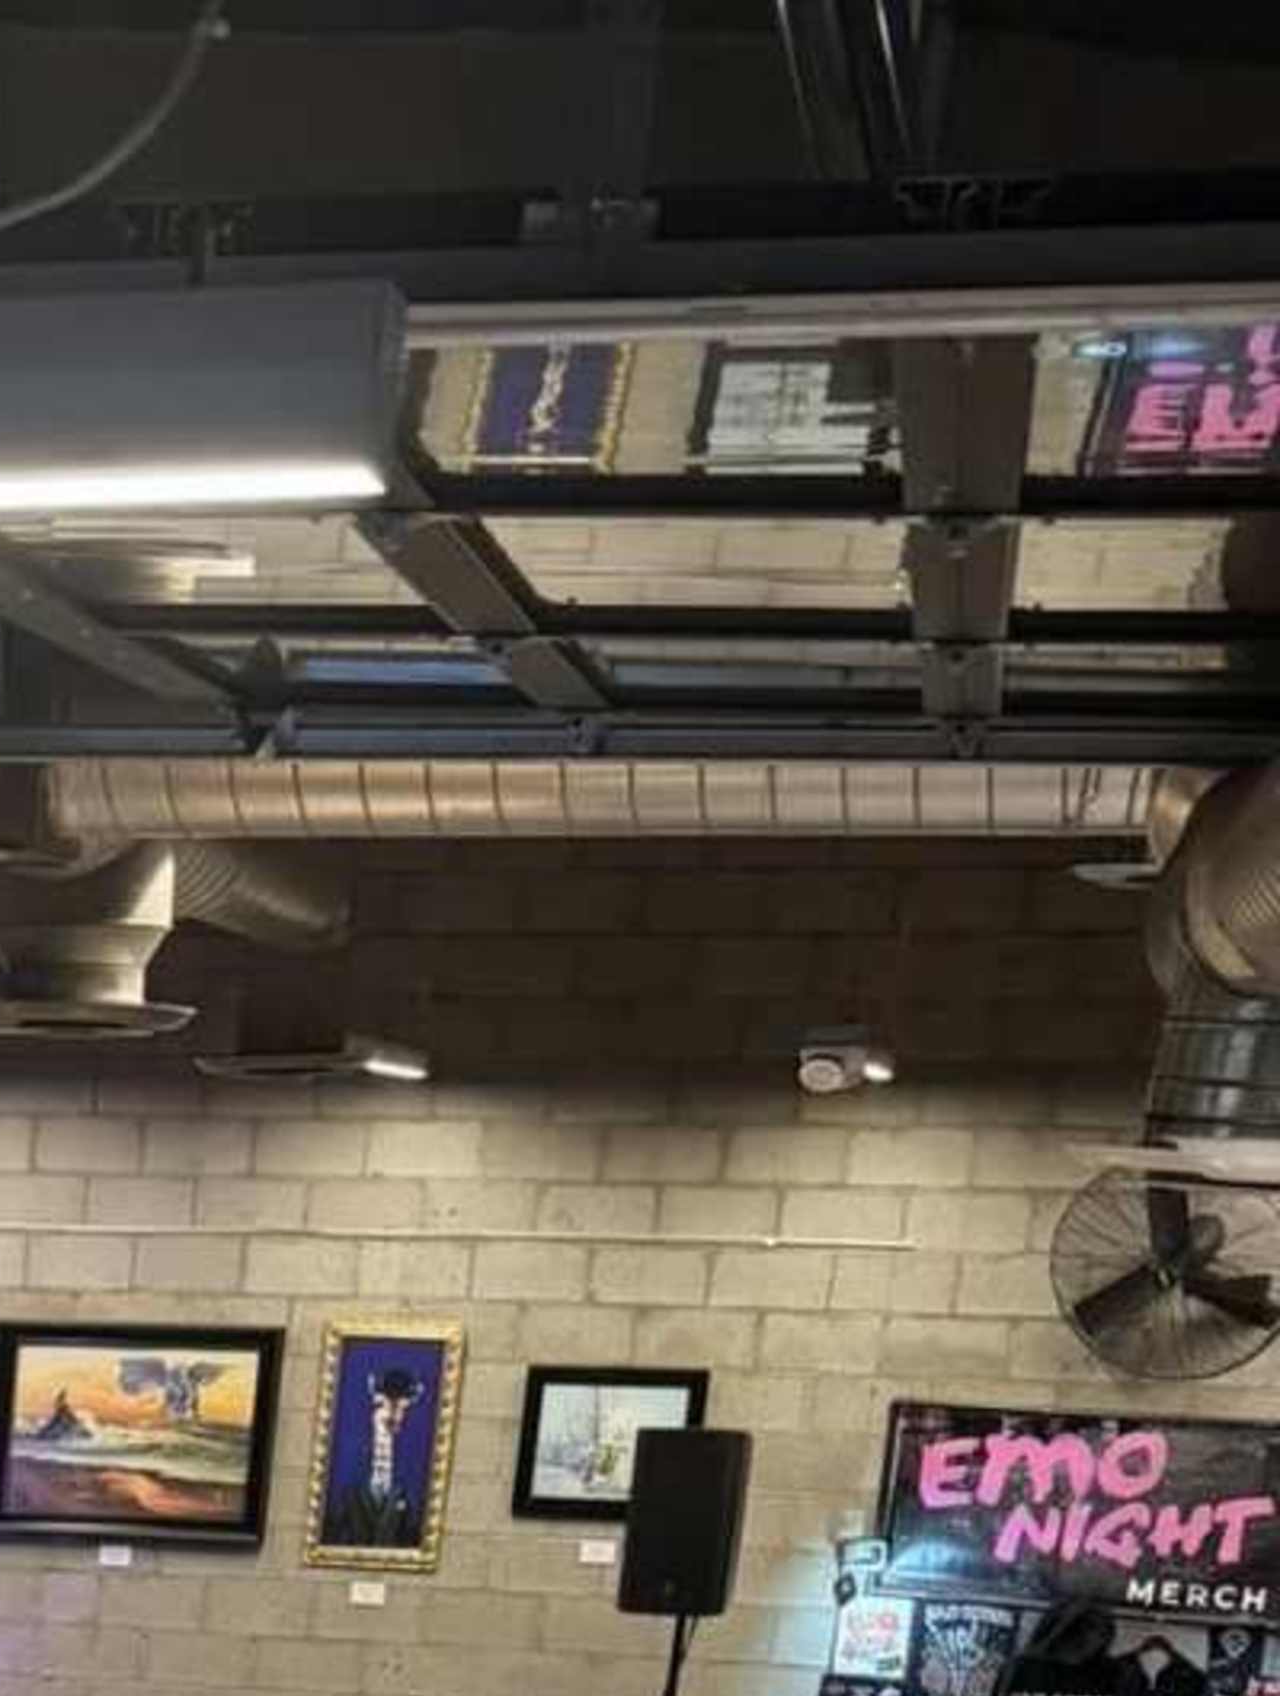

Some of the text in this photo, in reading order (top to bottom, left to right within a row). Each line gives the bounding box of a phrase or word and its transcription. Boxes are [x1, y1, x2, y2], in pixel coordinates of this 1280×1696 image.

[919, 1430, 1168, 1509] EMO
[994, 1496, 1274, 1568] NIGHT
[1126, 1578, 1267, 1613] MERCH
